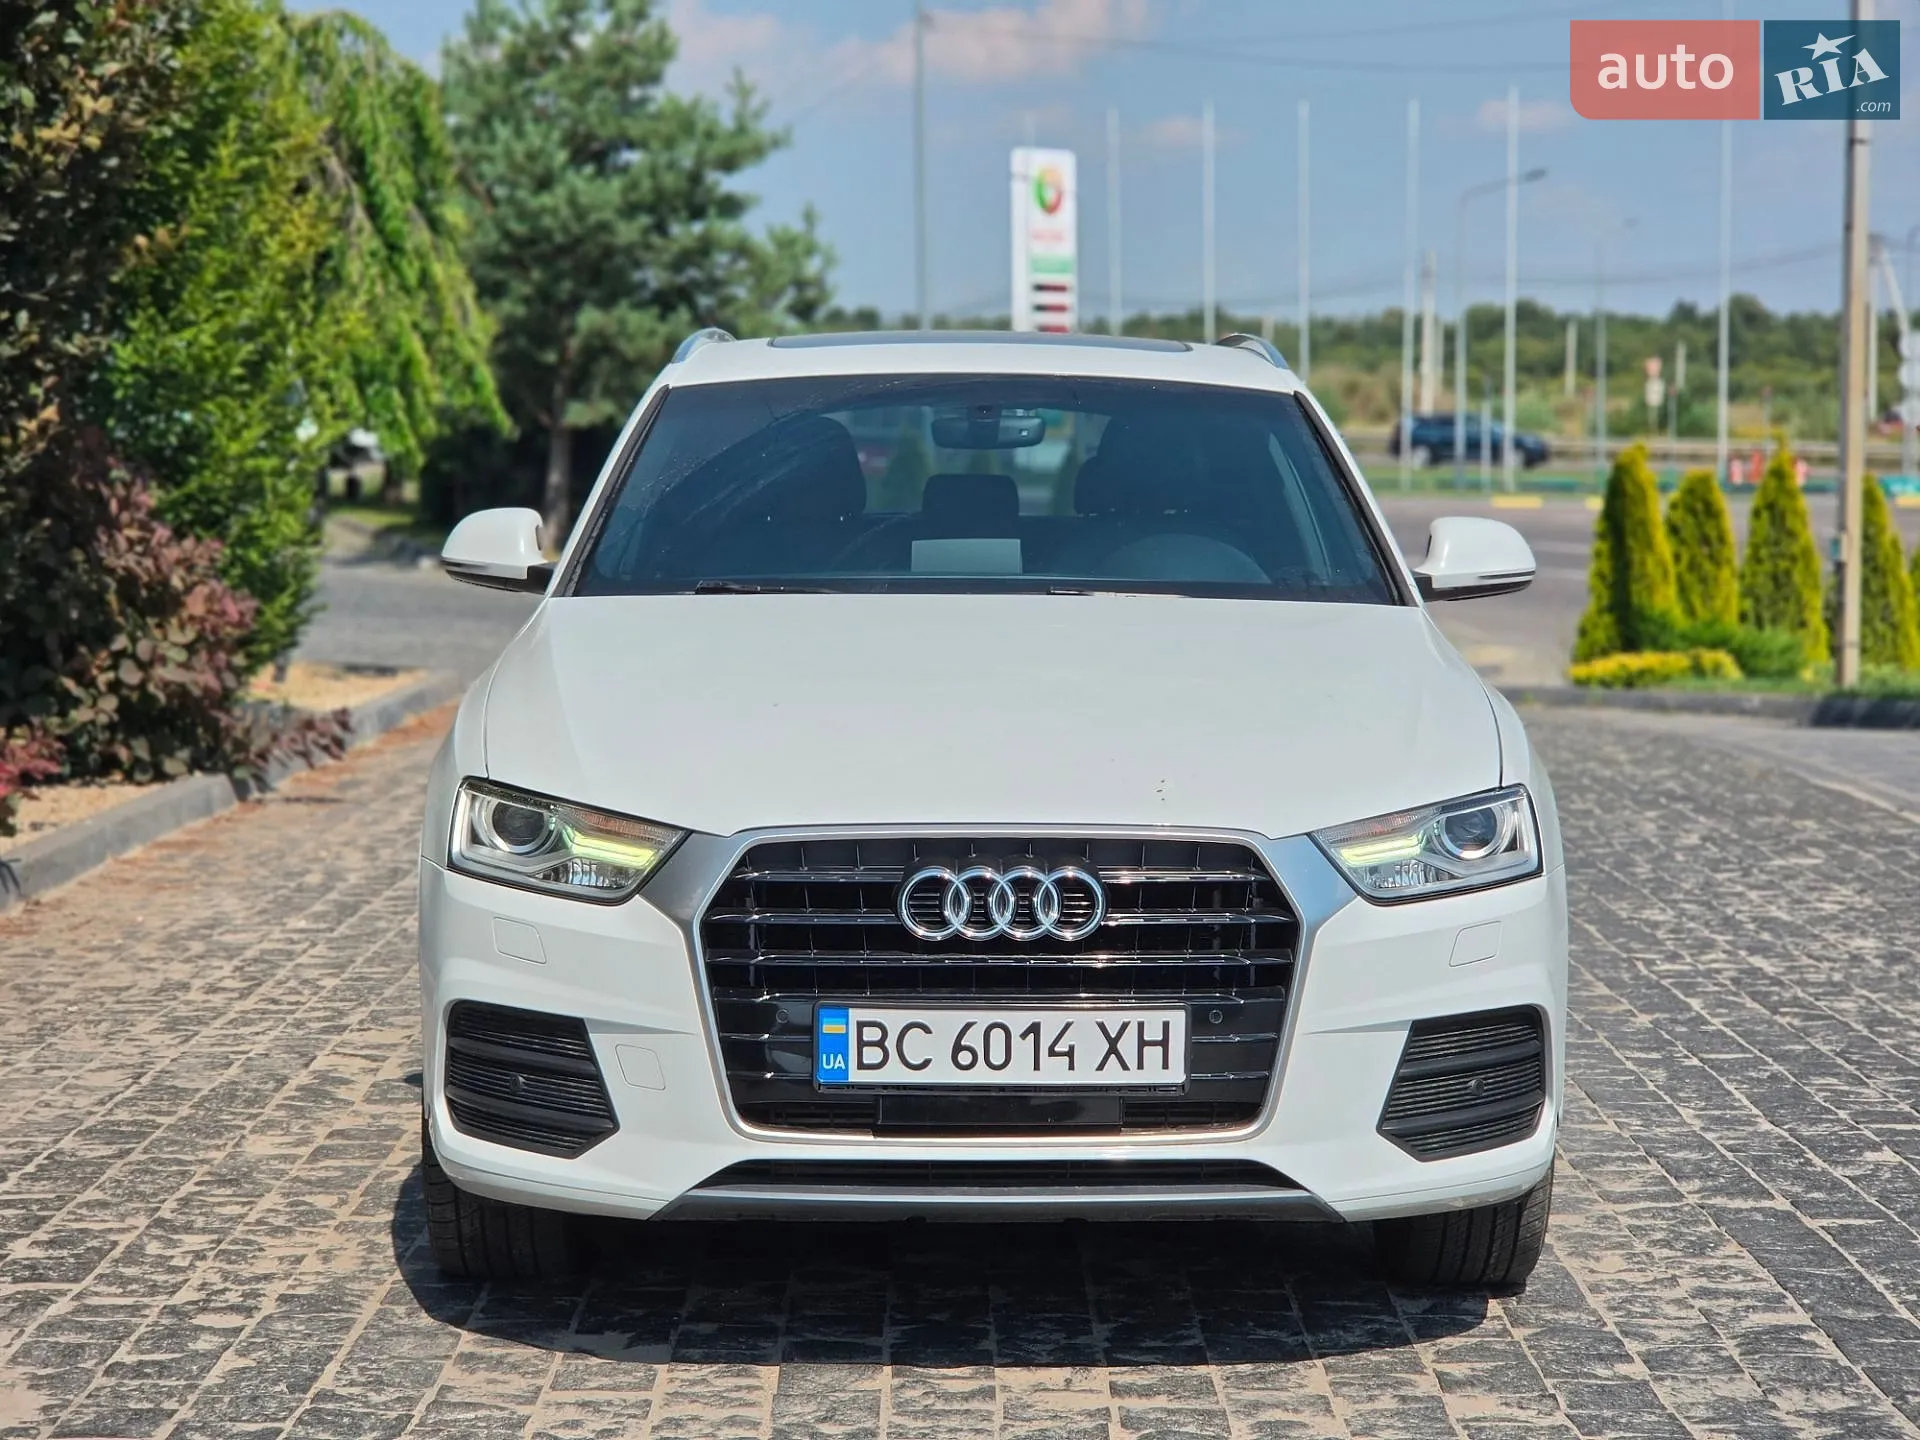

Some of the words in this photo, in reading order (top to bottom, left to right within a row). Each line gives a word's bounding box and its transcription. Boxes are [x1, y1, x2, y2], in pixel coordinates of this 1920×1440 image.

[822, 1054, 846, 1070] UA
[856, 1019, 933, 1071] BC
[951, 1020, 1075, 1071] 6014
[1095, 1020, 1170, 1071] XH
